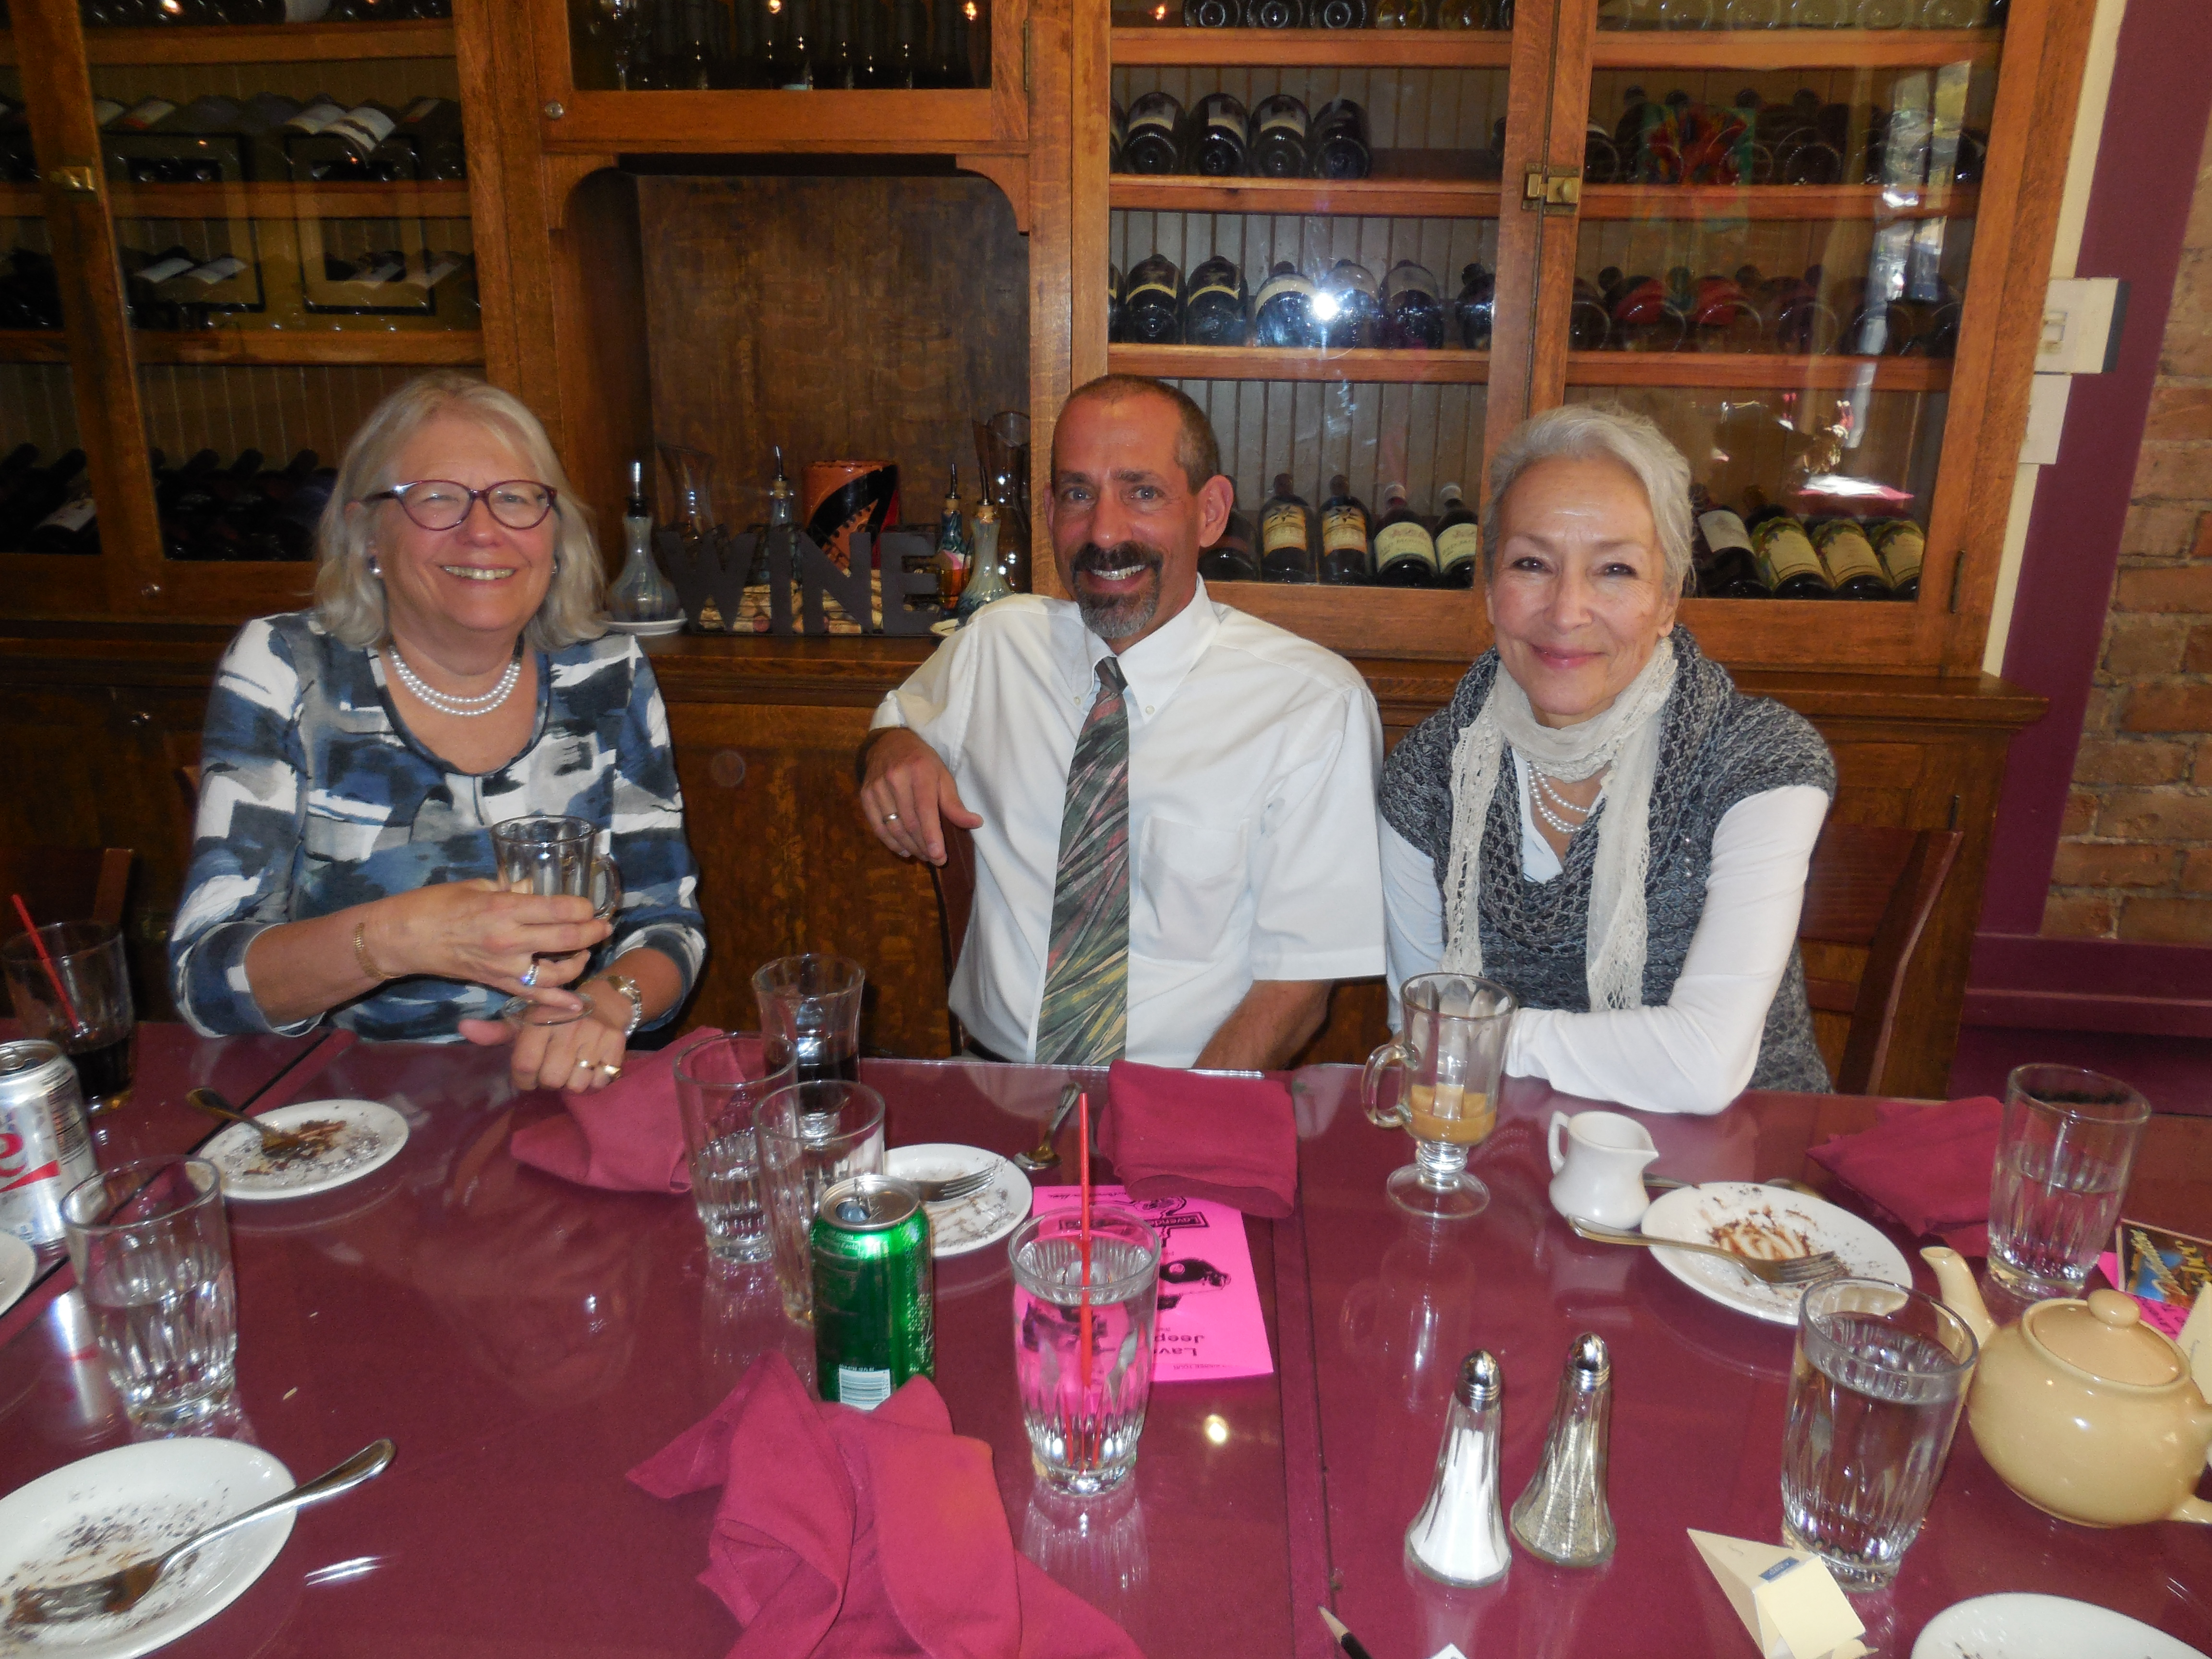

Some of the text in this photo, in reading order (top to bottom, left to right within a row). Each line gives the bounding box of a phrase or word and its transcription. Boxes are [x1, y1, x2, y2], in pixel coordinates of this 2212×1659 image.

[654, 531, 942, 635] WINE
[1149, 1217, 1200, 1227] Lavende
[1154, 1347, 1197, 1357] Lav
